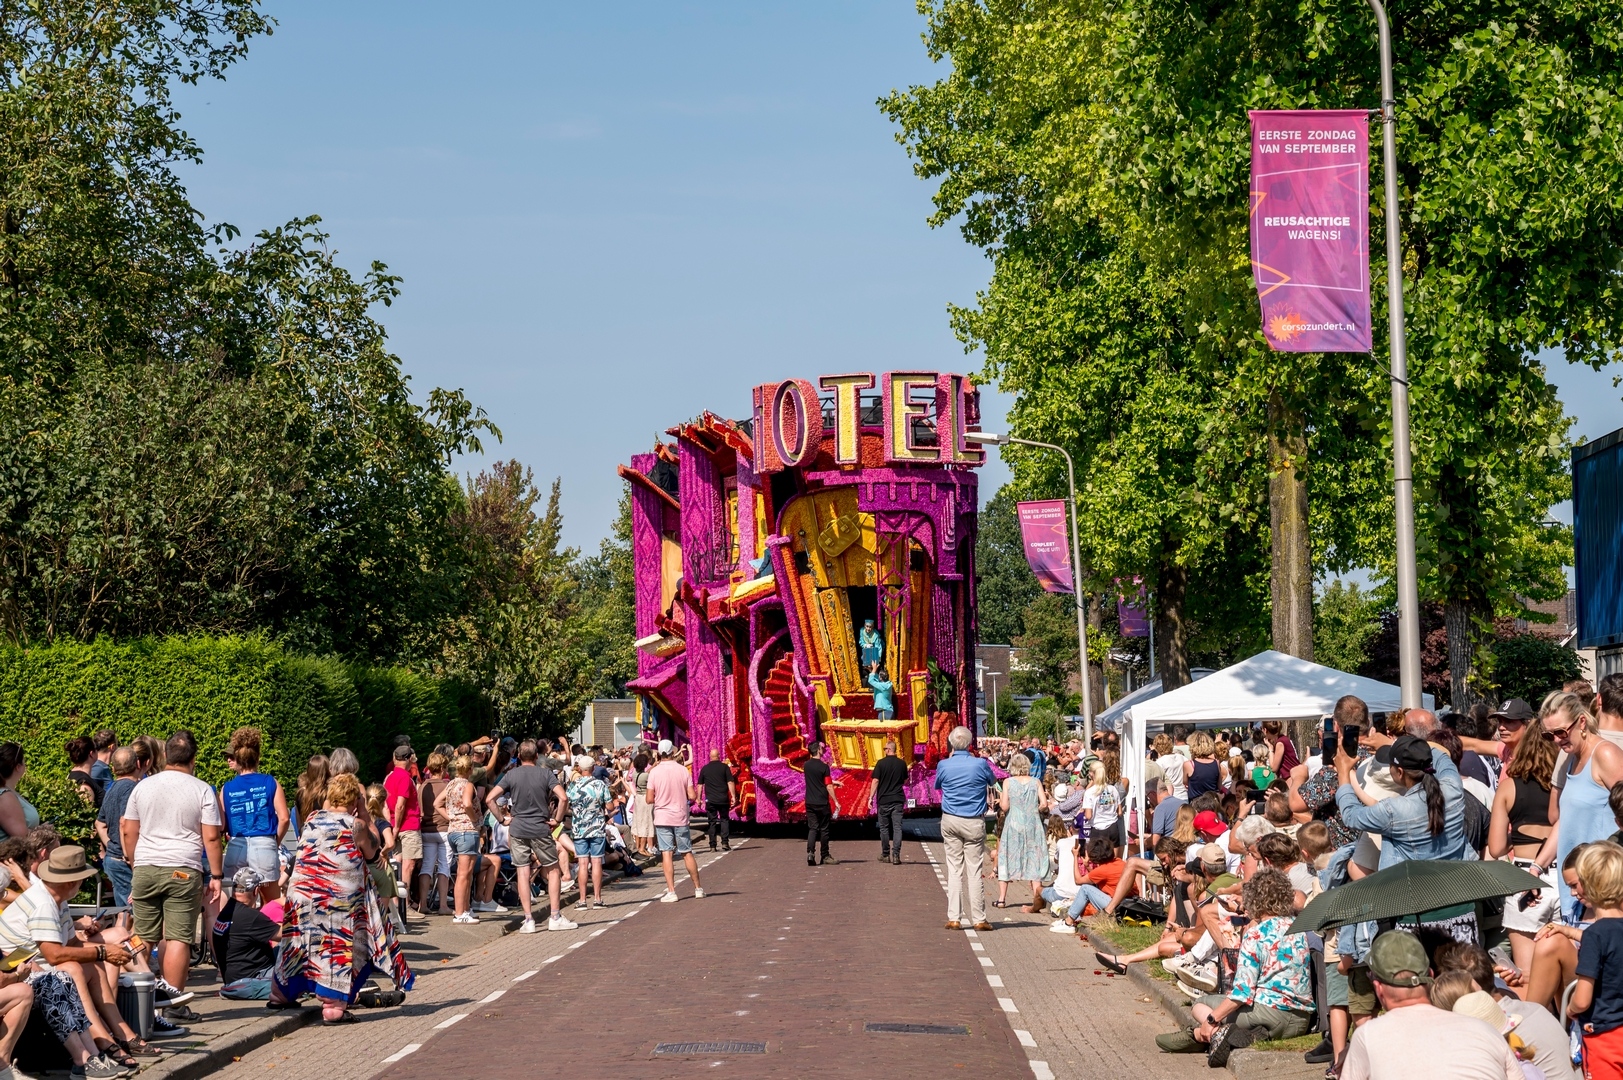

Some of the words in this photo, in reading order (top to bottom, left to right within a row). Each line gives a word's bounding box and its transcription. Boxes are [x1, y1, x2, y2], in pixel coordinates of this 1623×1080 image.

[1259, 130, 1302, 140] EERSTE
[1307, 130, 1356, 140] ZONDAG
[1259, 144, 1280, 153] VAN
[1284, 144, 1356, 153] SEPTEMBER
[1264, 216, 1350, 226] REUSACHTIGE
[1288, 230, 1341, 240] WAGENS!
[1281, 322, 1355, 331] corsozundert.nl
[752, 370, 987, 474] HOTEL
